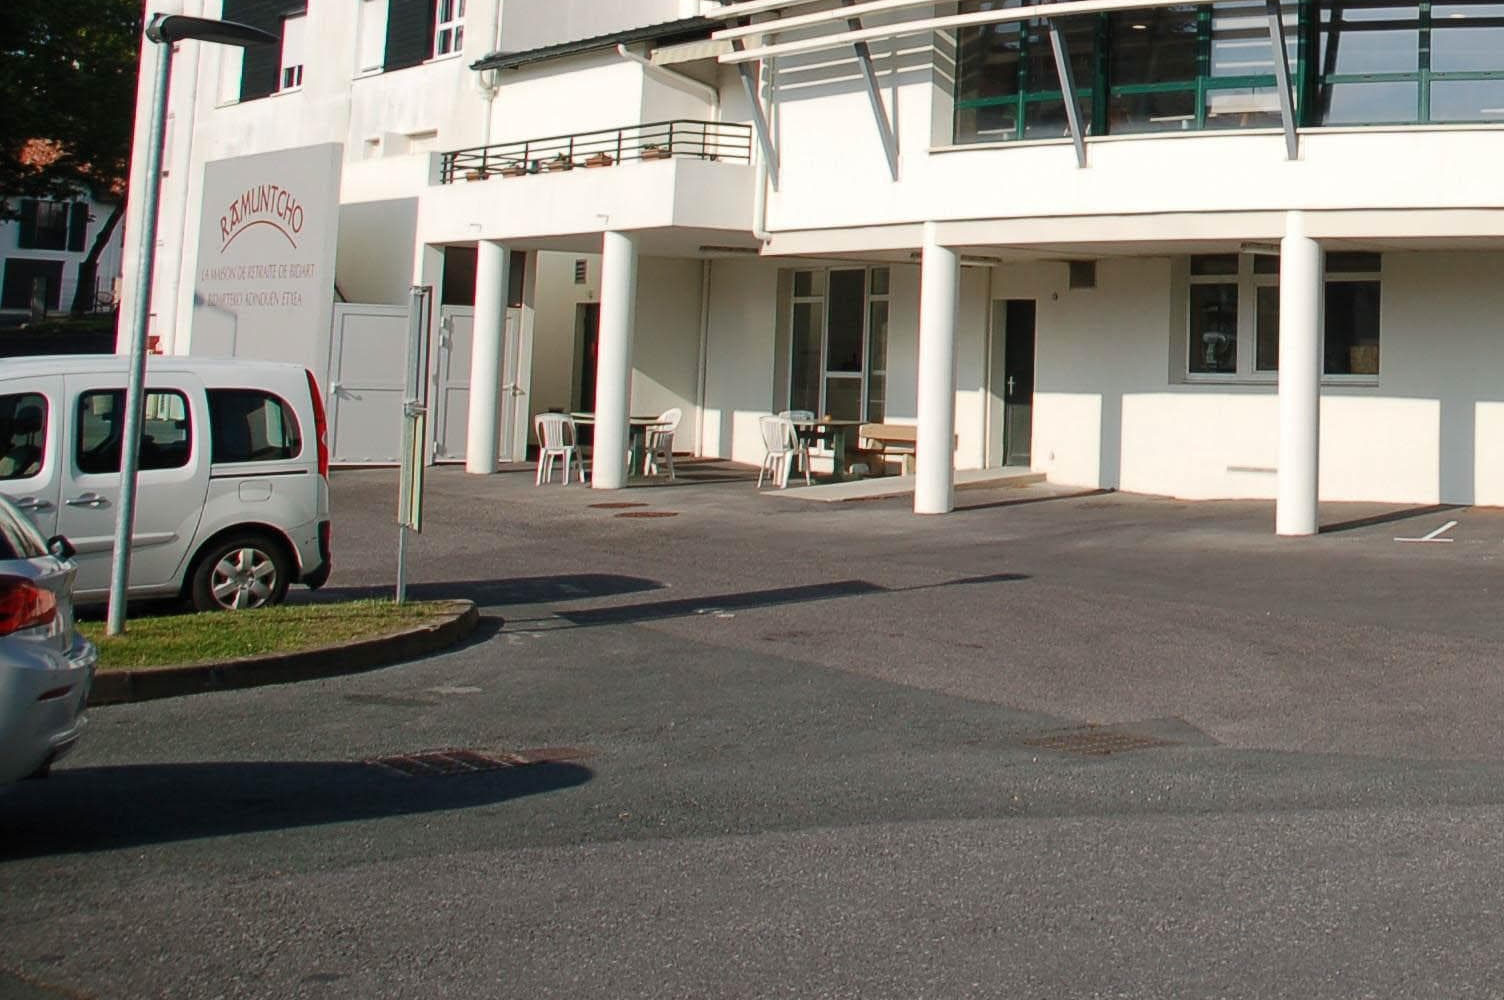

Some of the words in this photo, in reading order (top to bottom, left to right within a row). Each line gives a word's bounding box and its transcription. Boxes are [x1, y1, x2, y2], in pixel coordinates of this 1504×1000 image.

[220, 183, 304, 241] RAMUNTCHO
[210, 265, 236, 281] MAISON
[238, 264, 246, 280] DE
[247, 263, 277, 280] RETRAITE
[279, 263, 288, 279] DE
[289, 263, 315, 279] BIDART
